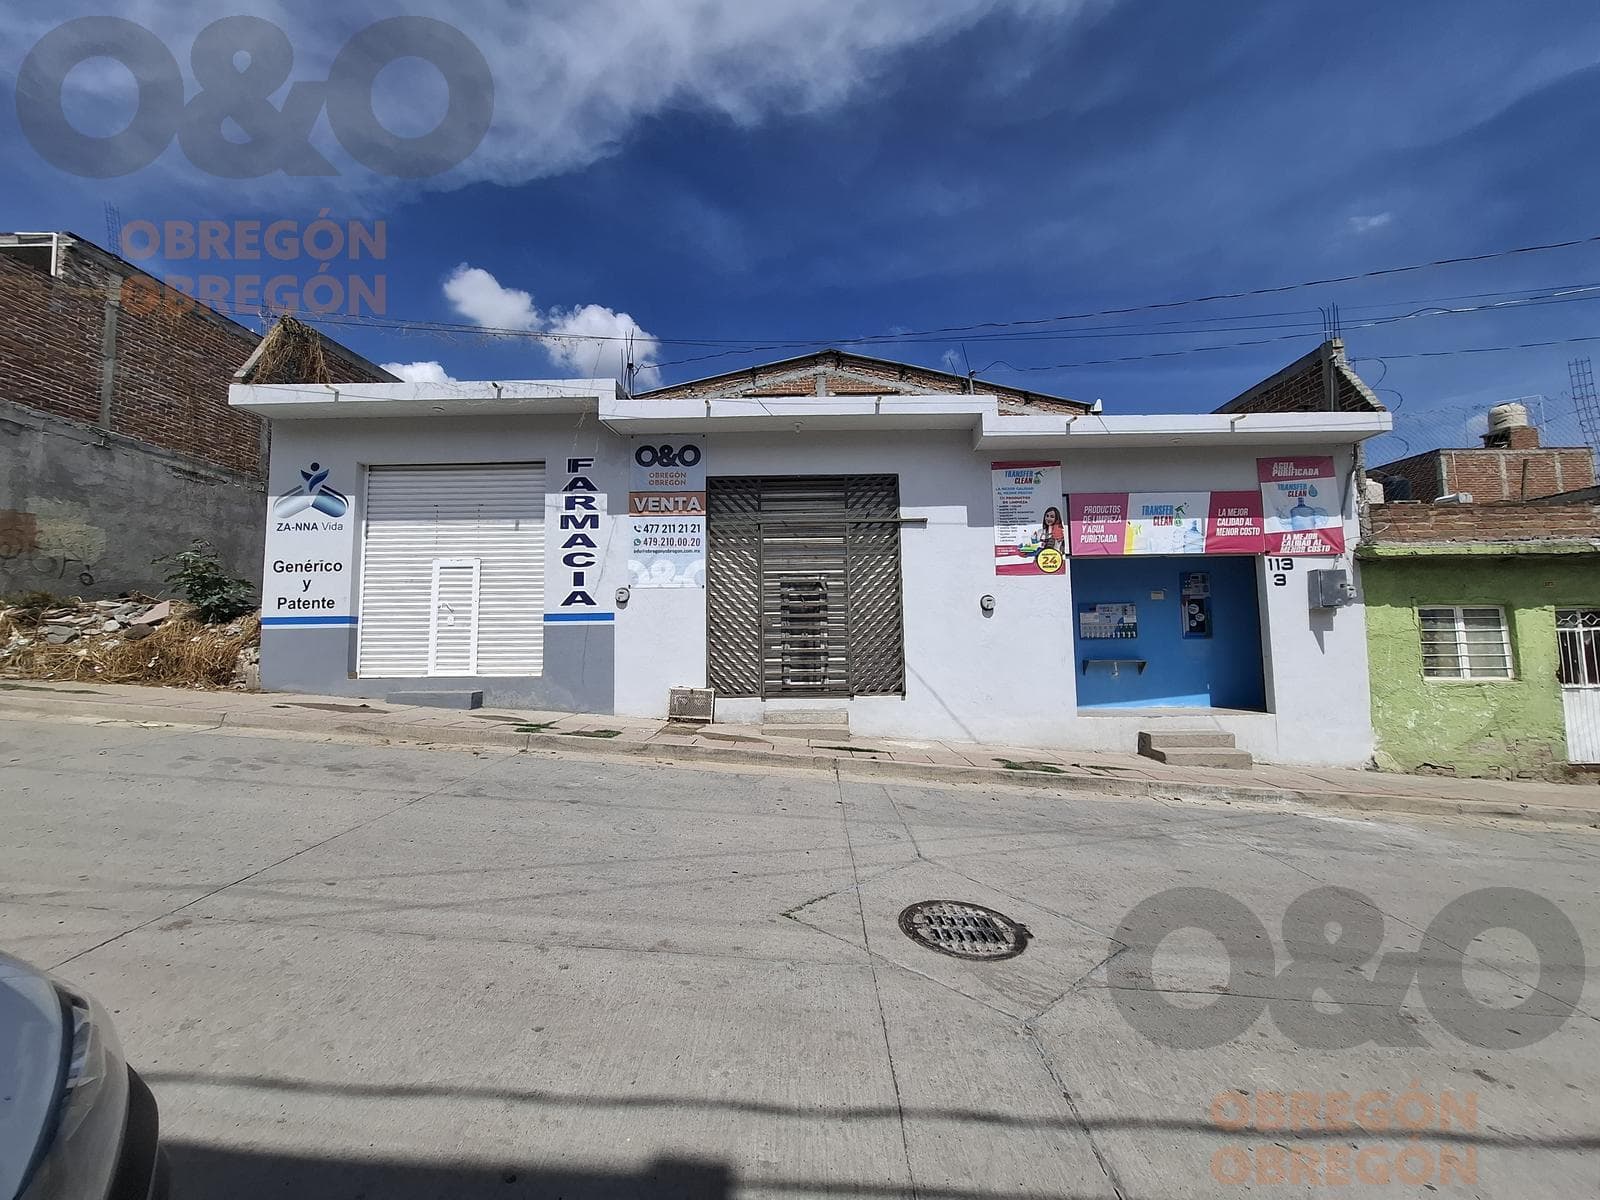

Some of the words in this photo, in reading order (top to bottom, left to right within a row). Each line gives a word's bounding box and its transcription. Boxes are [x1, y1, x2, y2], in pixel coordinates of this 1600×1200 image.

[635, 444, 702, 467] O&O
[1272, 462, 1295, 470] AGUA
[648, 470, 687, 479] OBREGÓN
[1004, 470, 1034, 478] TRANSFER
[1272, 468, 1320, 477] PURIFICADA
[1014, 477, 1033, 485] CLEAN
[1277, 483, 1308, 491] TRANSFER
[1287, 490, 1307, 498] CLEAN
[634, 496, 702, 513] VENTA
[1083, 505, 1121, 514] PRODUCTOS
[1142, 505, 1174, 516] TRANSFER
[1218, 508, 1227, 517] LA
[1227, 508, 1249, 516] MEJOR
[1082, 515, 1091, 524] DE
[1092, 515, 1122, 524] LIMPIEZA
[1153, 516, 1173, 526] CLEAN
[1216, 518, 1244, 527] CALIDAD
[1244, 517, 1253, 526] AL
[276, 522, 318, 532] ZA-NNA
[321, 521, 343, 532] Vida
[643, 523, 660, 534] 477
[662, 524, 676, 534] 211
[678, 523, 688, 533] 21
[690, 523, 701, 534] 21
[1081, 525, 1087, 534] Y
[1087, 525, 1105, 533] AGUA
[560, 457, 600, 607] FARMACIA
[1215, 527, 1240, 537] MENOR
[1240, 527, 1260, 536] COSTO
[1080, 534, 1118, 544] PURIFICADA
[1042, 556, 1058, 565] 24
[1267, 557, 1294, 571] 113
[272, 559, 343, 574] Genérico
[1274, 573, 1287, 587] 3
[302, 579, 312, 593] y
[277, 597, 336, 610] Patente
